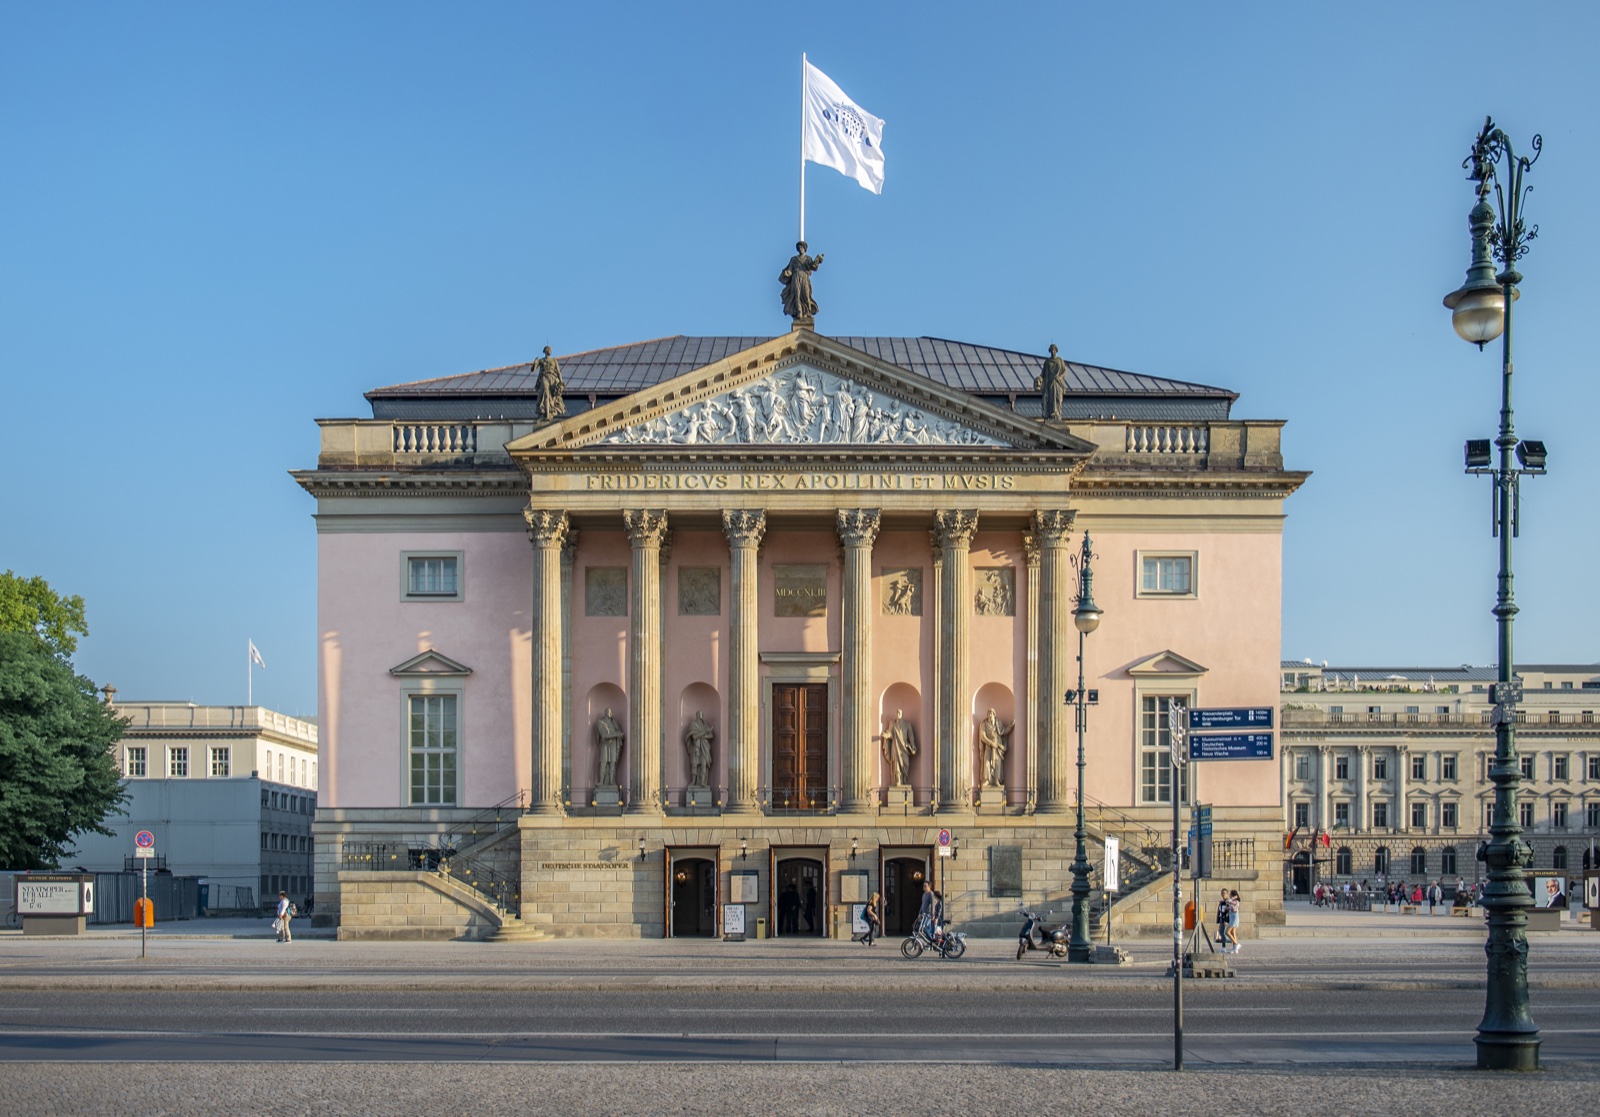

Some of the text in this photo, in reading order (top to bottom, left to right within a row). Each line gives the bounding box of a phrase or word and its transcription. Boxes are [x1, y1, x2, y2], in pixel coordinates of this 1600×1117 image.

[586, 475, 1015, 490] FRIDERICVS REX APOLLINI ET MVSIS
[776, 588, 826, 596] MDCCXLIII
